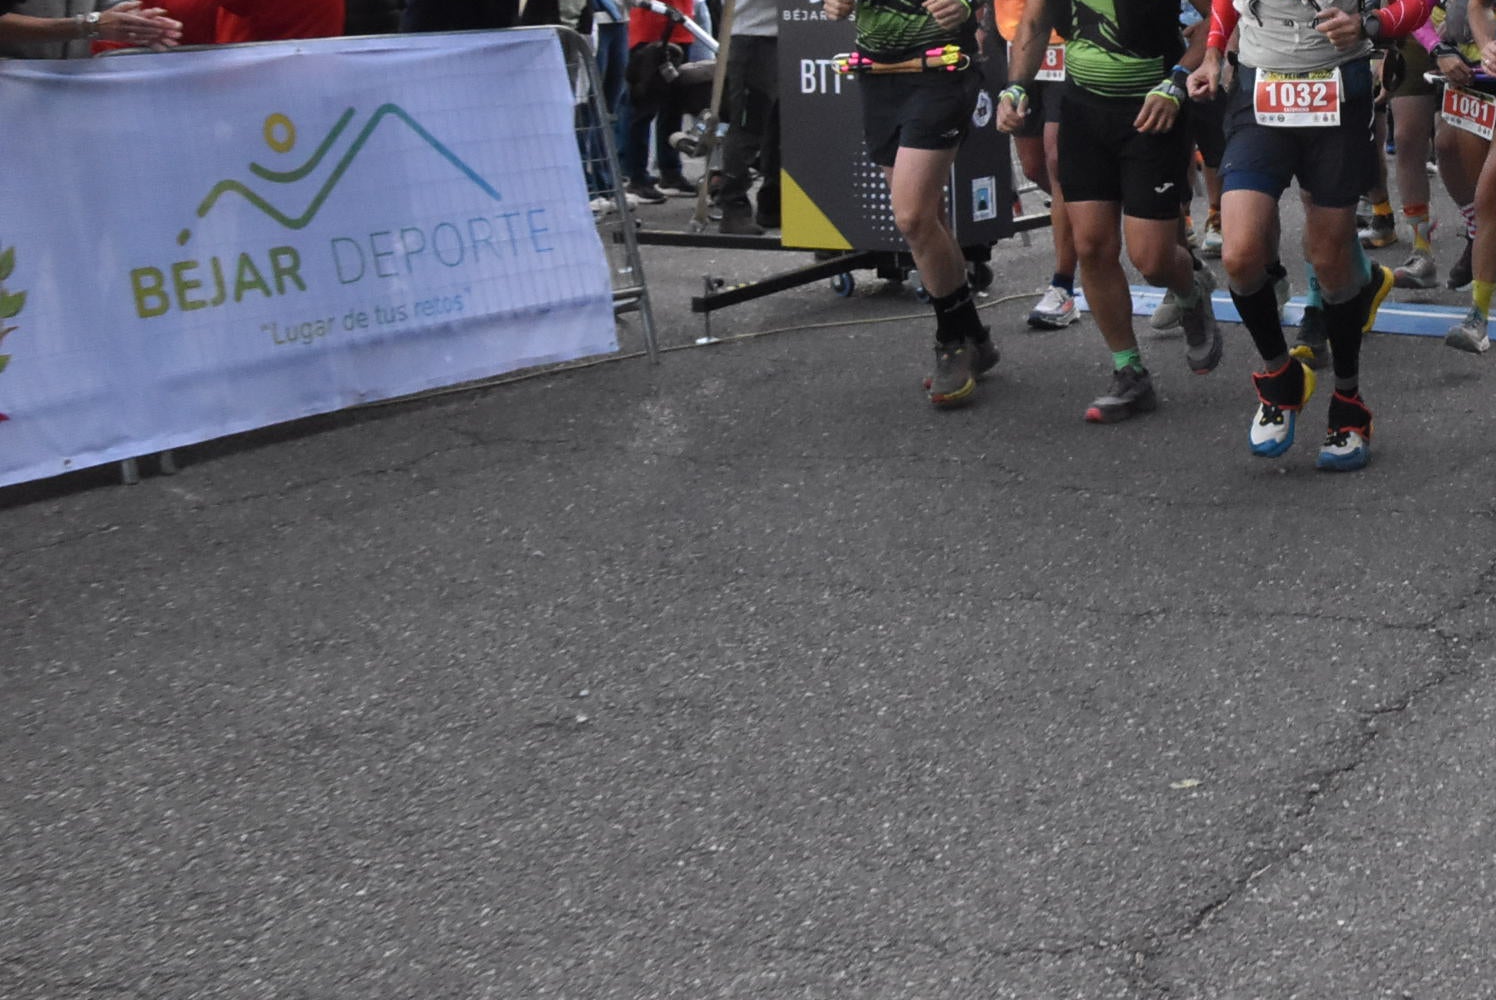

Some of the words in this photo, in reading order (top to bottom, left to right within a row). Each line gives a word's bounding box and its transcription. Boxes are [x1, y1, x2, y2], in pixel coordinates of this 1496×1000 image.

[1265, 82, 1328, 107] 1032
[1451, 93, 1489, 123] 1001
[330, 208, 555, 285] DEPORTE
[342, 307, 370, 332] de
[374, 303, 409, 326] tus
